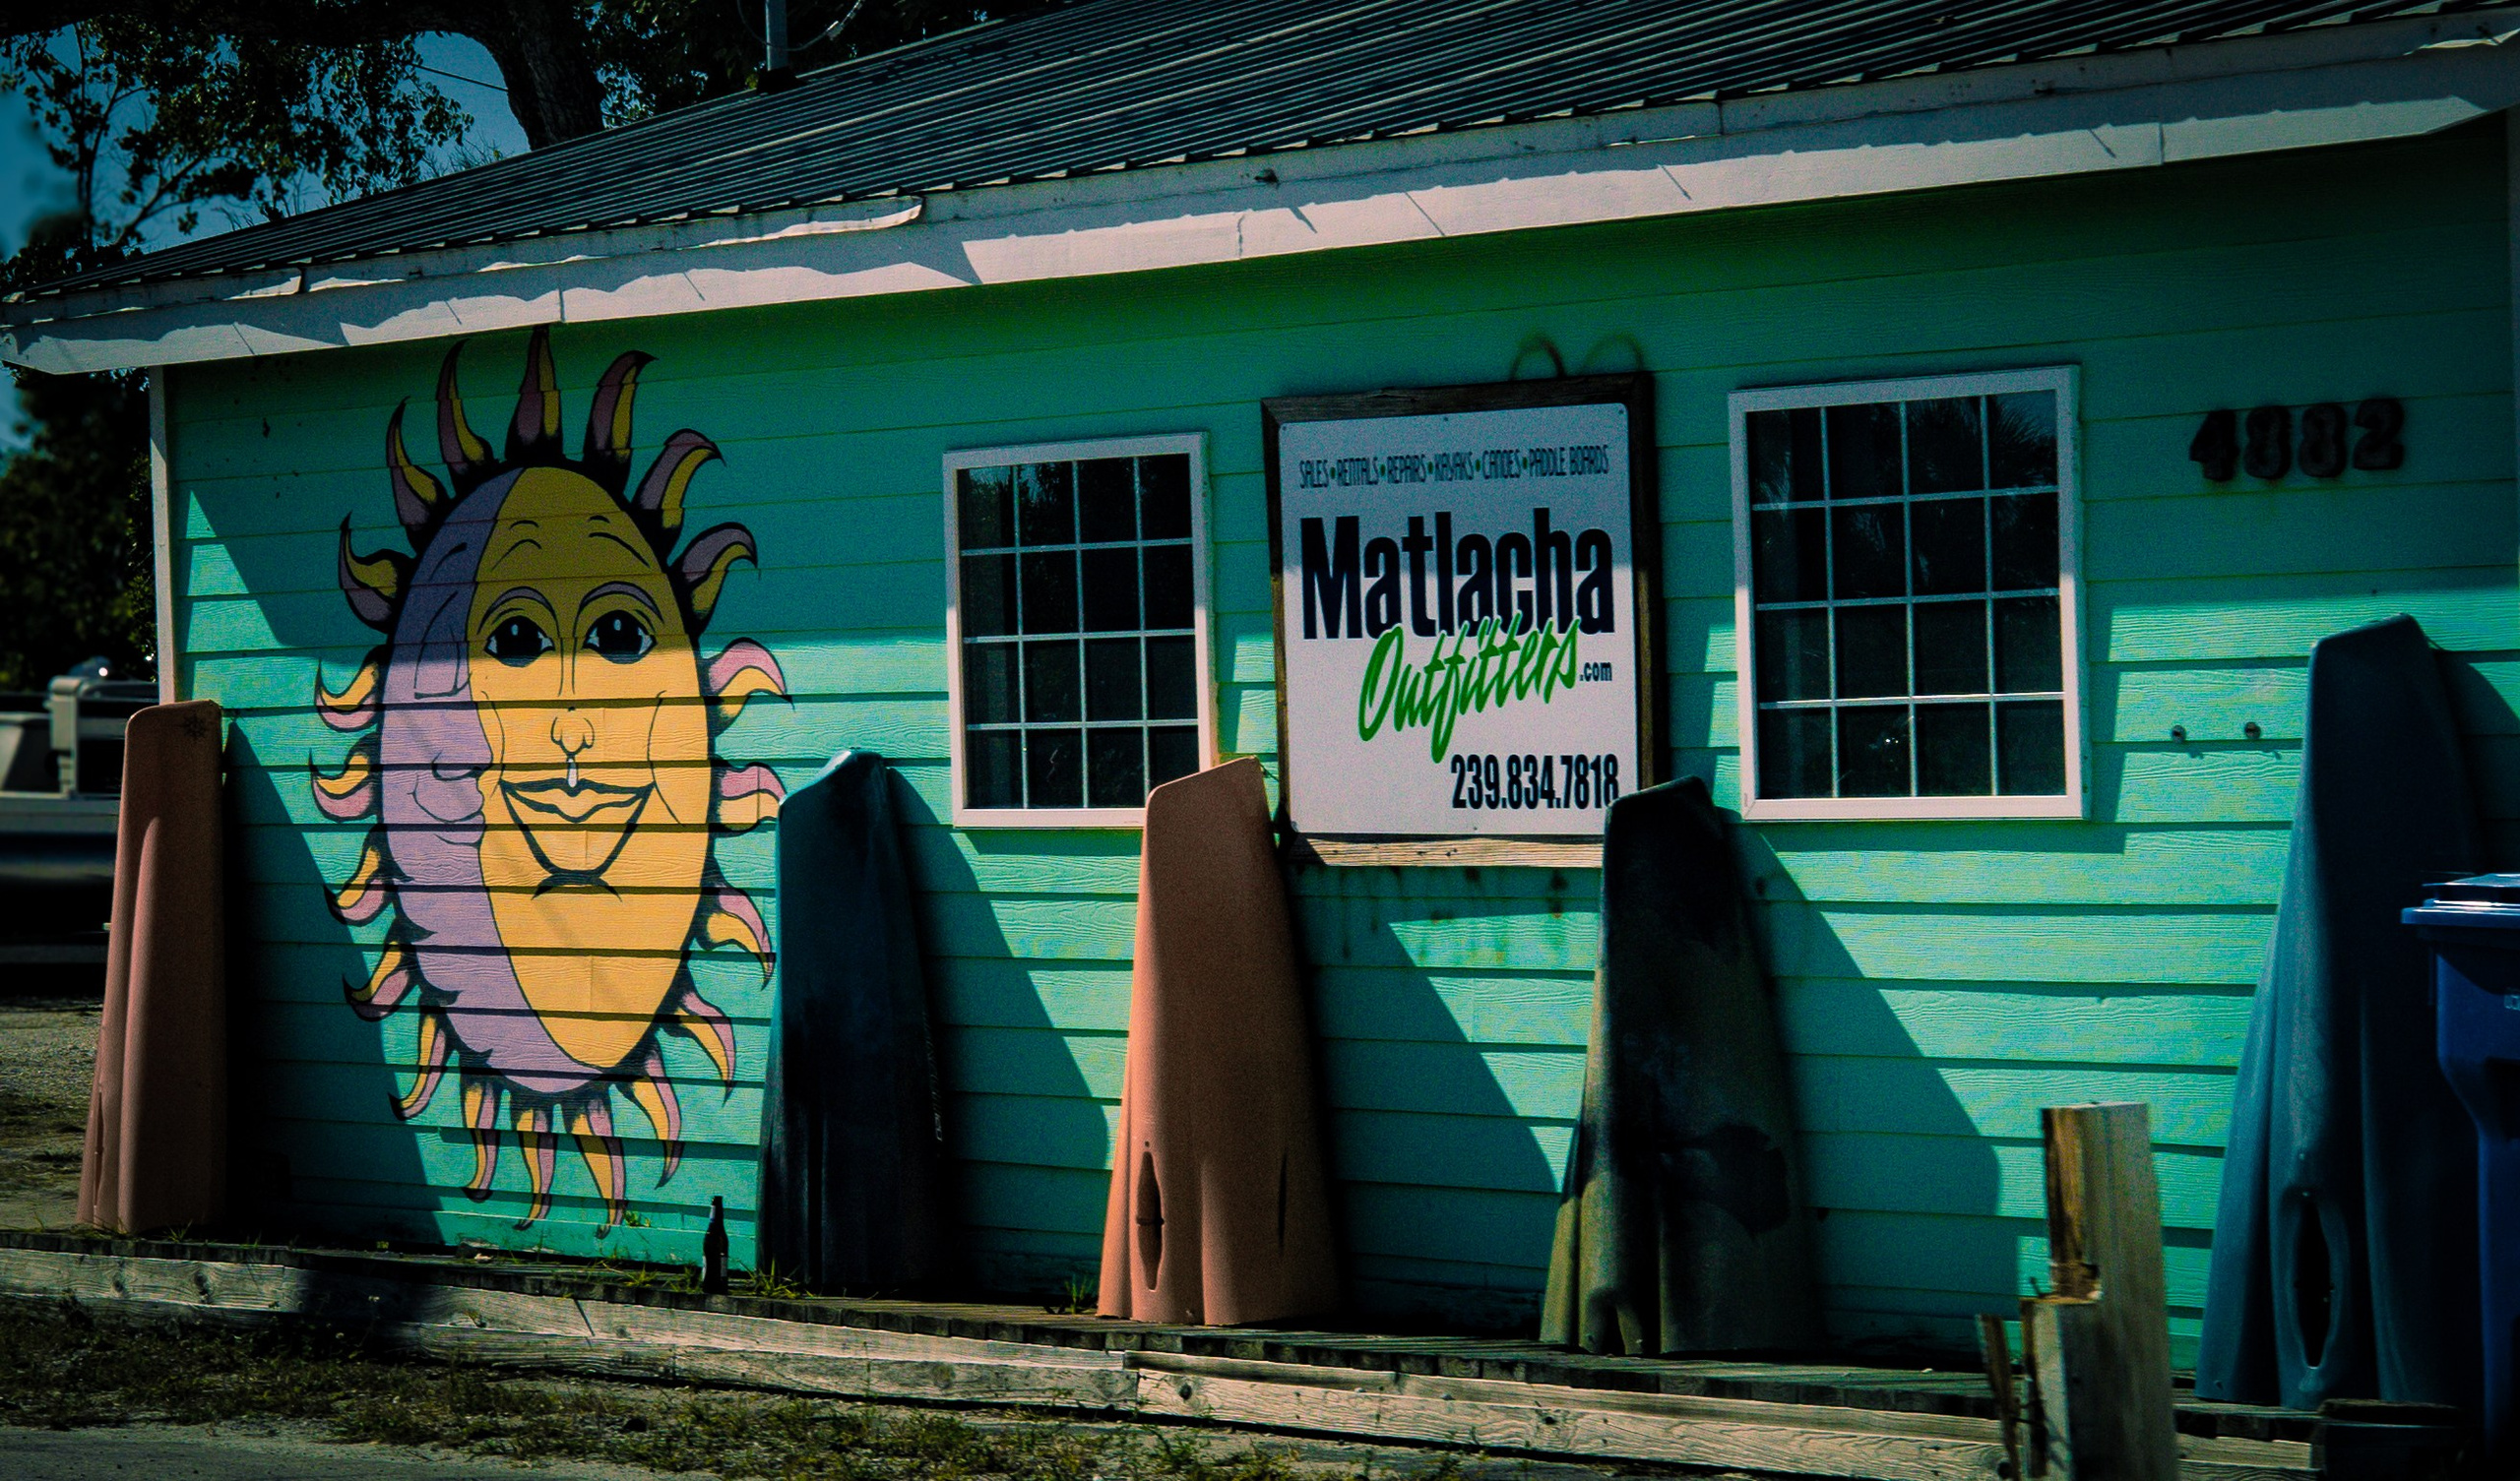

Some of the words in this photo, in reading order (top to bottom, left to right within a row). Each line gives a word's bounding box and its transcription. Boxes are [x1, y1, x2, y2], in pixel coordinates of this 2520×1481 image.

[1299, 460, 1329, 489] SALES
[1337, 456, 1378, 487] RENTALS
[1387, 454, 1426, 484] REPAIRS
[1433, 451, 1475, 482] KAYAKS
[1482, 449, 1522, 480] CANOES
[1529, 446, 1567, 477] PADDLE
[1569, 444, 1609, 475] BOARDS
[1300, 507, 1615, 640] Matlacha
[1358, 612, 1581, 764] Outfitters
[1579, 661, 1612, 682] .com
[1451, 754, 1618, 809] 239.834.7818
